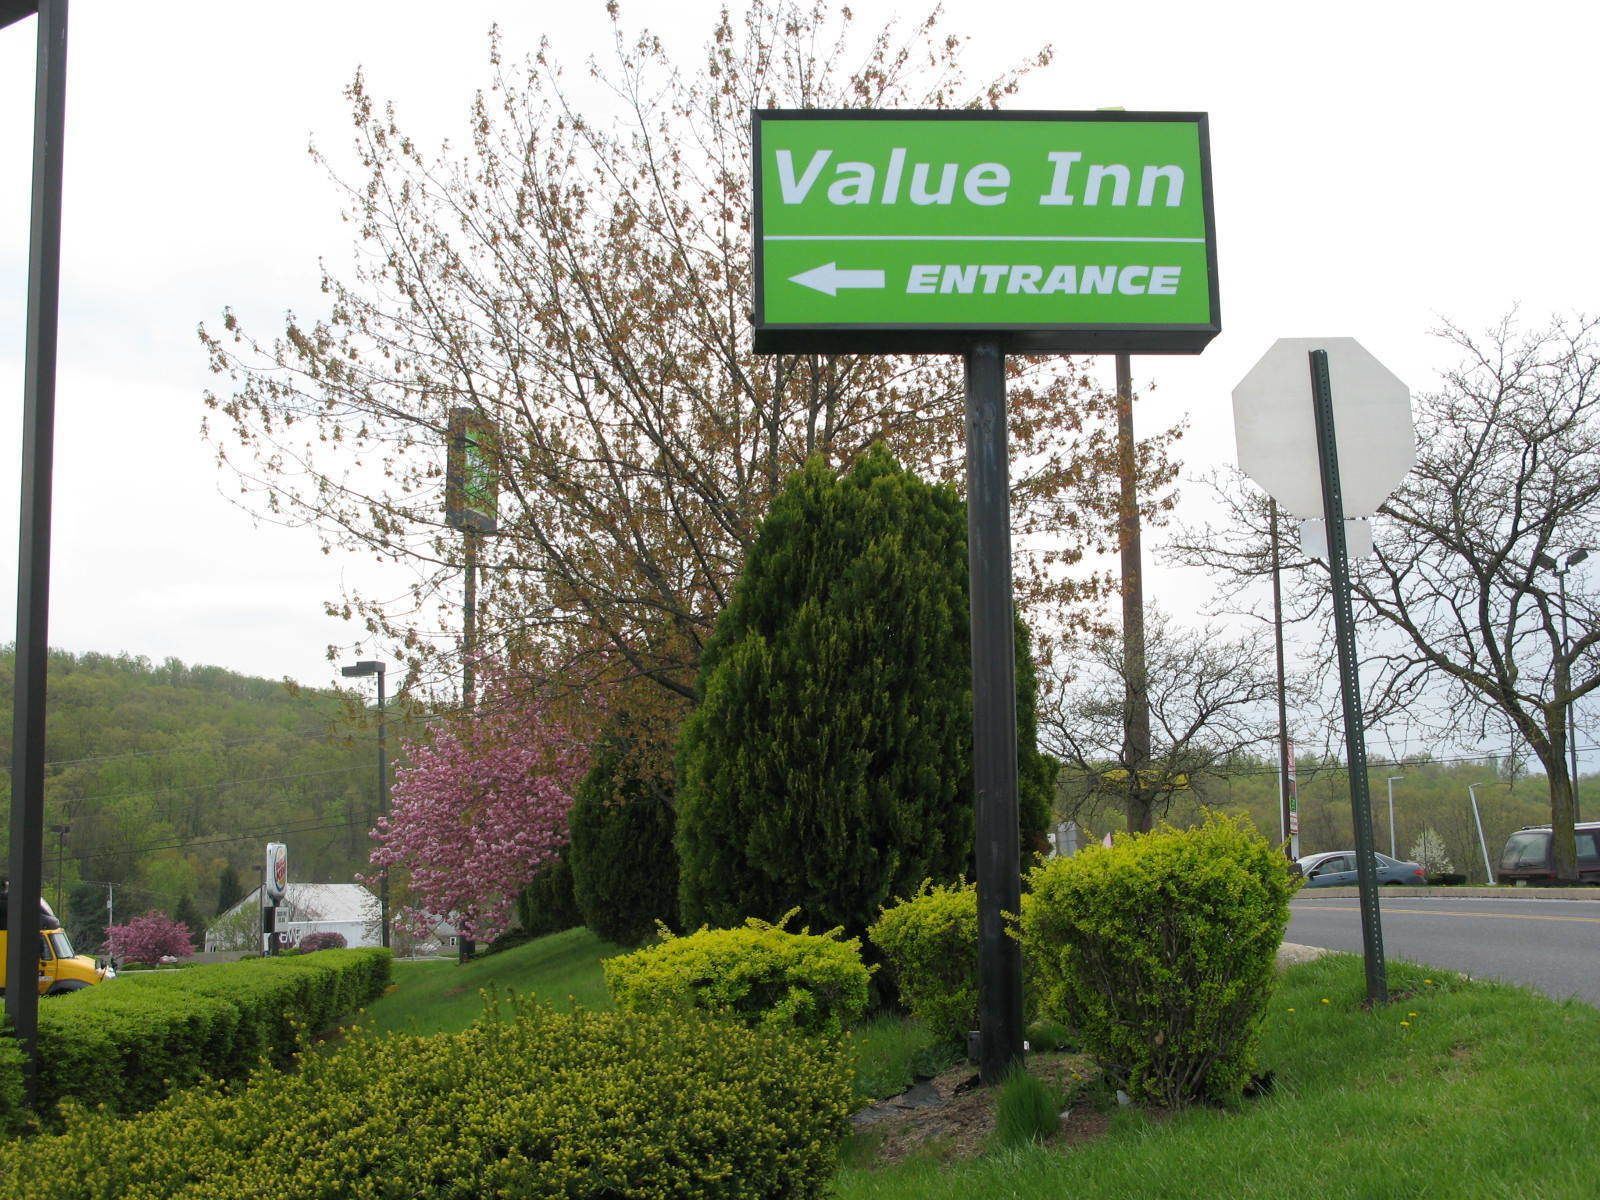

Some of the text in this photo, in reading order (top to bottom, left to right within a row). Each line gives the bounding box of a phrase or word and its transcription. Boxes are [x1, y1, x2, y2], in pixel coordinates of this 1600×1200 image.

[775, 147, 1185, 207] Value Inn
[906, 264, 1182, 295] ENTRANCE
